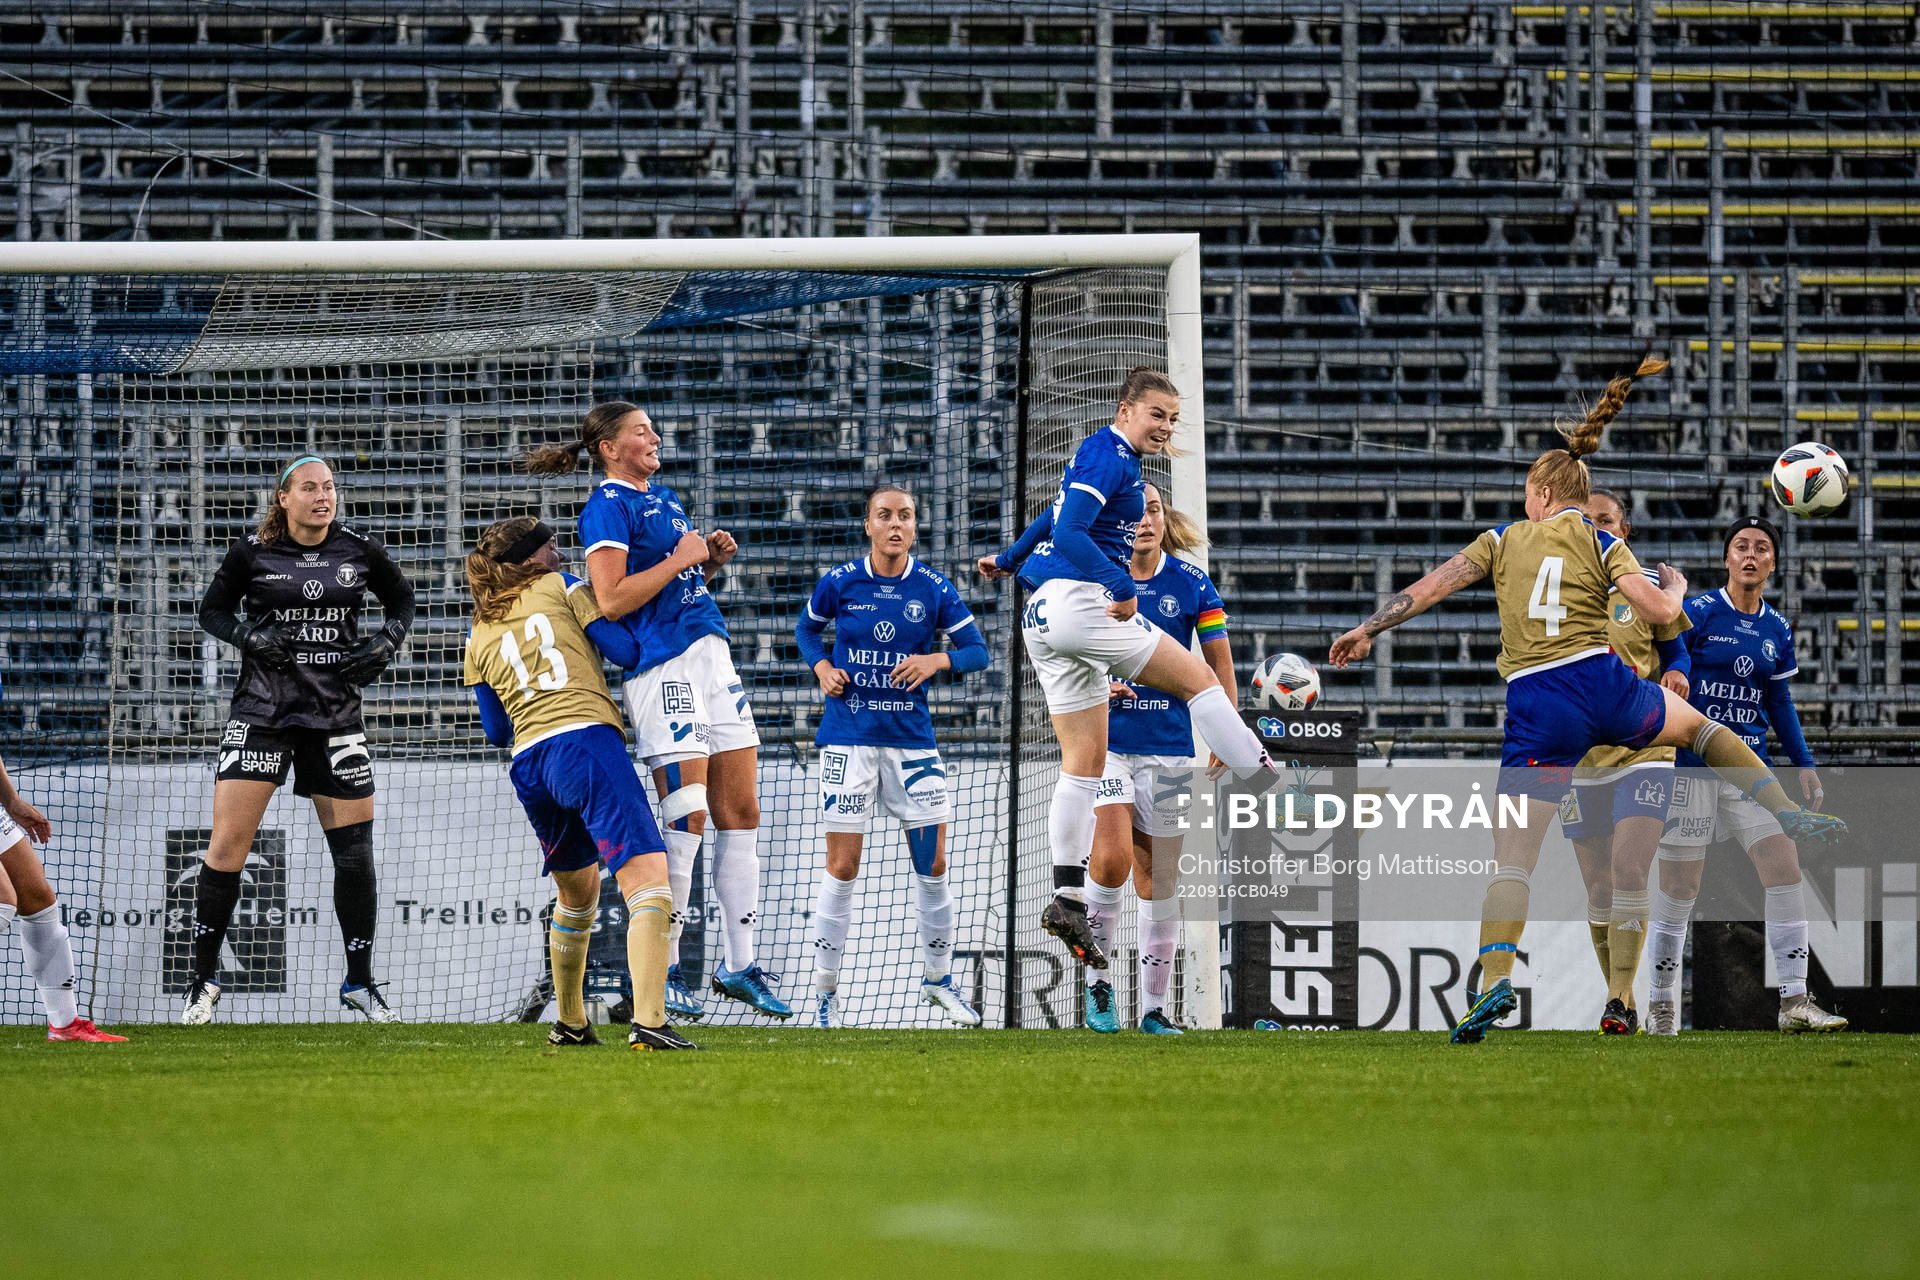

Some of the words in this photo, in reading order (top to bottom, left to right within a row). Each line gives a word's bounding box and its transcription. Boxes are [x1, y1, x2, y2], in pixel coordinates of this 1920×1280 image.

[917, 566, 943, 585] akea
[1180, 562, 1204, 581] akea
[1528, 556, 1567, 637] 4
[273, 607, 351, 623] MELLBY
[294, 623, 339, 642] ÅRD
[296, 652, 344, 664] SIGM
[499, 612, 569, 701] 13
[848, 648, 914, 667] MELLB
[1706, 703, 1758, 724] GÅRD
[694, 722, 711, 733] INTE
[1289, 722, 1342, 738] OBOS
[242, 750, 281, 762] INTER
[241, 760, 280, 774] SPORT
[1098, 778, 1123, 790] TER
[839, 794, 866, 804] INTER
[1096, 788, 1123, 799] PORT
[1634, 788, 1666, 804] LKF
[838, 804, 865, 814] SPORT
[1682, 816, 1711, 828] INTER
[1680, 827, 1710, 838] SPORT
